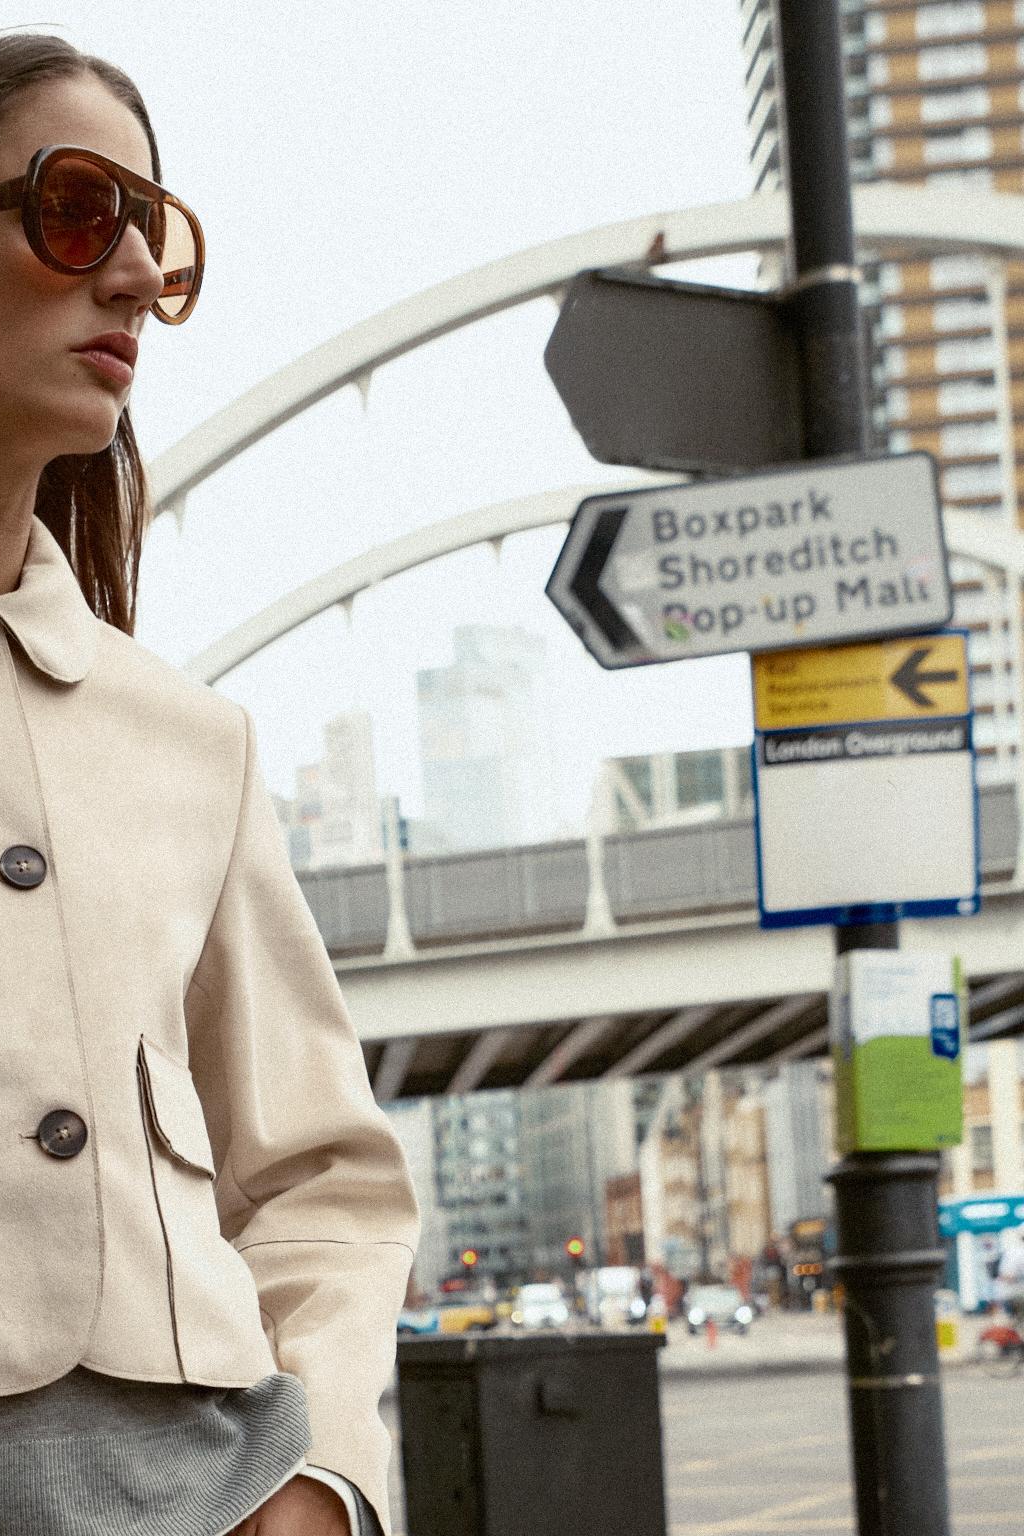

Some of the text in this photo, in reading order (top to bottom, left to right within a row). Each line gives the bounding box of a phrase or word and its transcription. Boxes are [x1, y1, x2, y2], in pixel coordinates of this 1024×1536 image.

[652, 490, 830, 543] Boxpark
[658, 529, 897, 589] Shoreditch
[836, 575, 929, 612] Mall
[765, 725, 963, 763] London Overground
